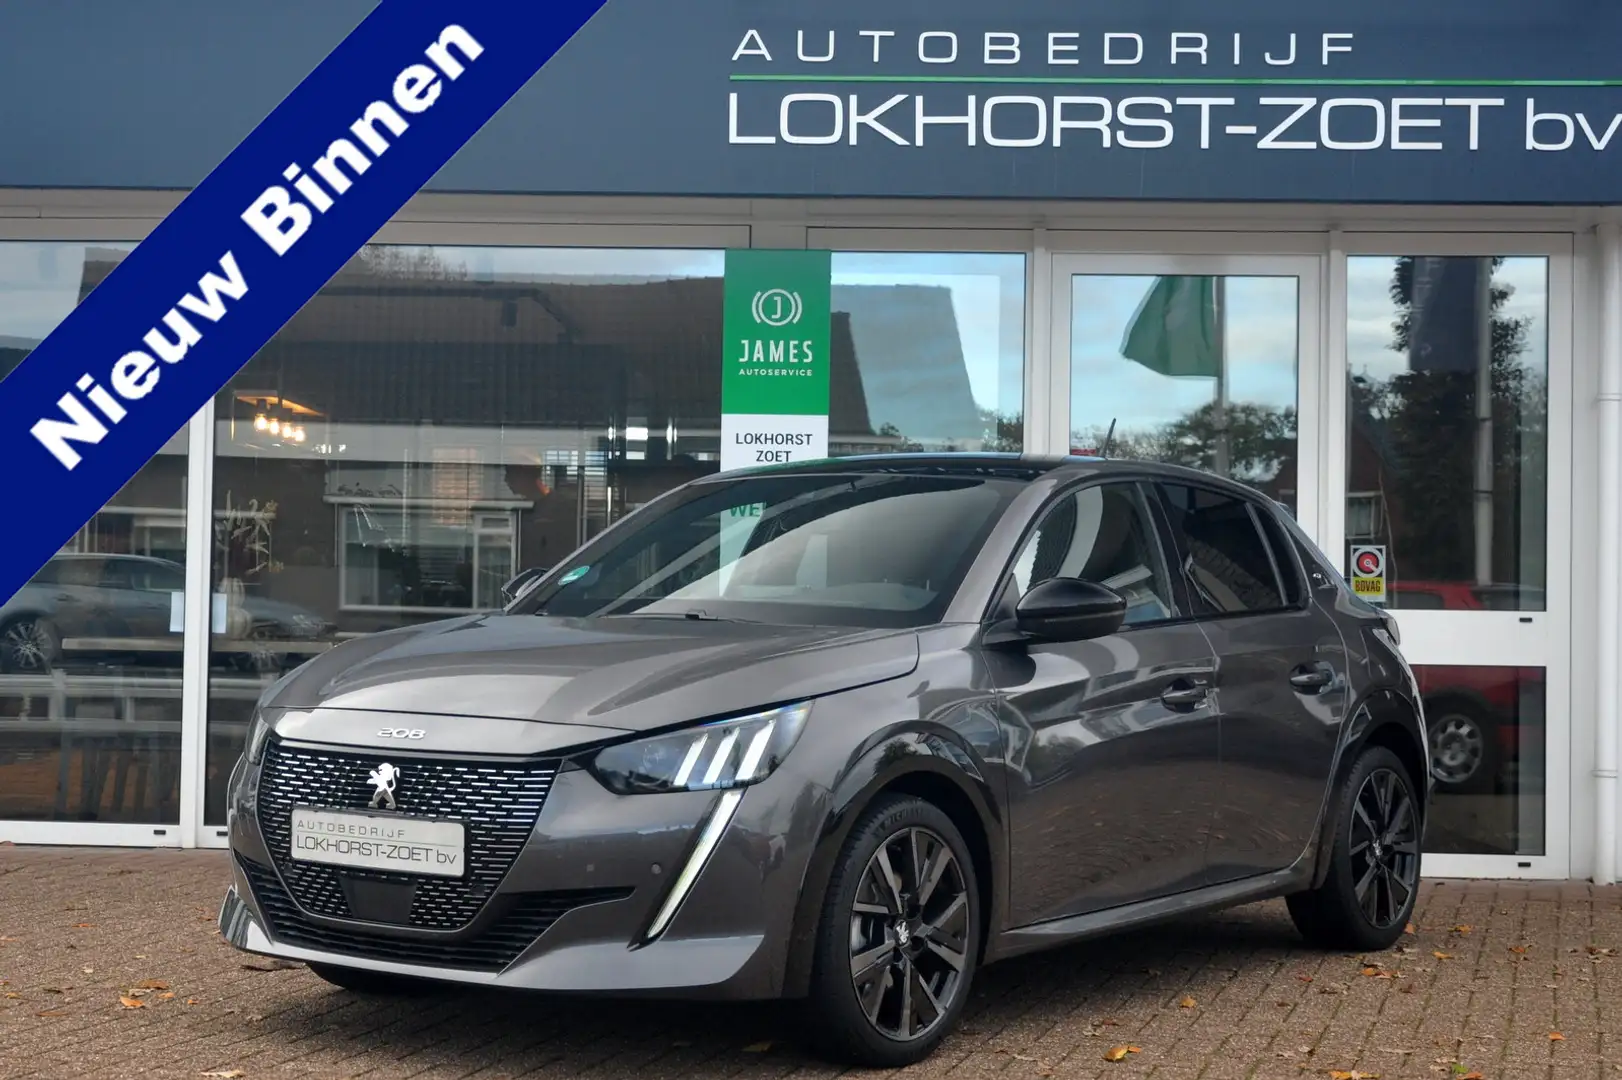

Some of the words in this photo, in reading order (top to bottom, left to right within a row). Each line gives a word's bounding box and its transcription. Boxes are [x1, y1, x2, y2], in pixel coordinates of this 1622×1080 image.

[731, 29, 1355, 67] AUTOBEDRIJF
[728, 92, 1505, 151] LOKHORST-ZOET
[1525, 97, 1622, 151] bv
[738, 339, 814, 363] JAMES
[738, 368, 814, 377] AUTOSERVICE
[735, 432, 814, 446] LOKHORST
[755, 450, 792, 463] ZOET
[1355, 579, 1381, 592] BOVAG
[377, 728, 426, 740] 208
[297, 819, 406, 838] AUTOBEDRIJF
[297, 835, 432, 862] LOKHORST-ZOET
[436, 849, 457, 864] bv
